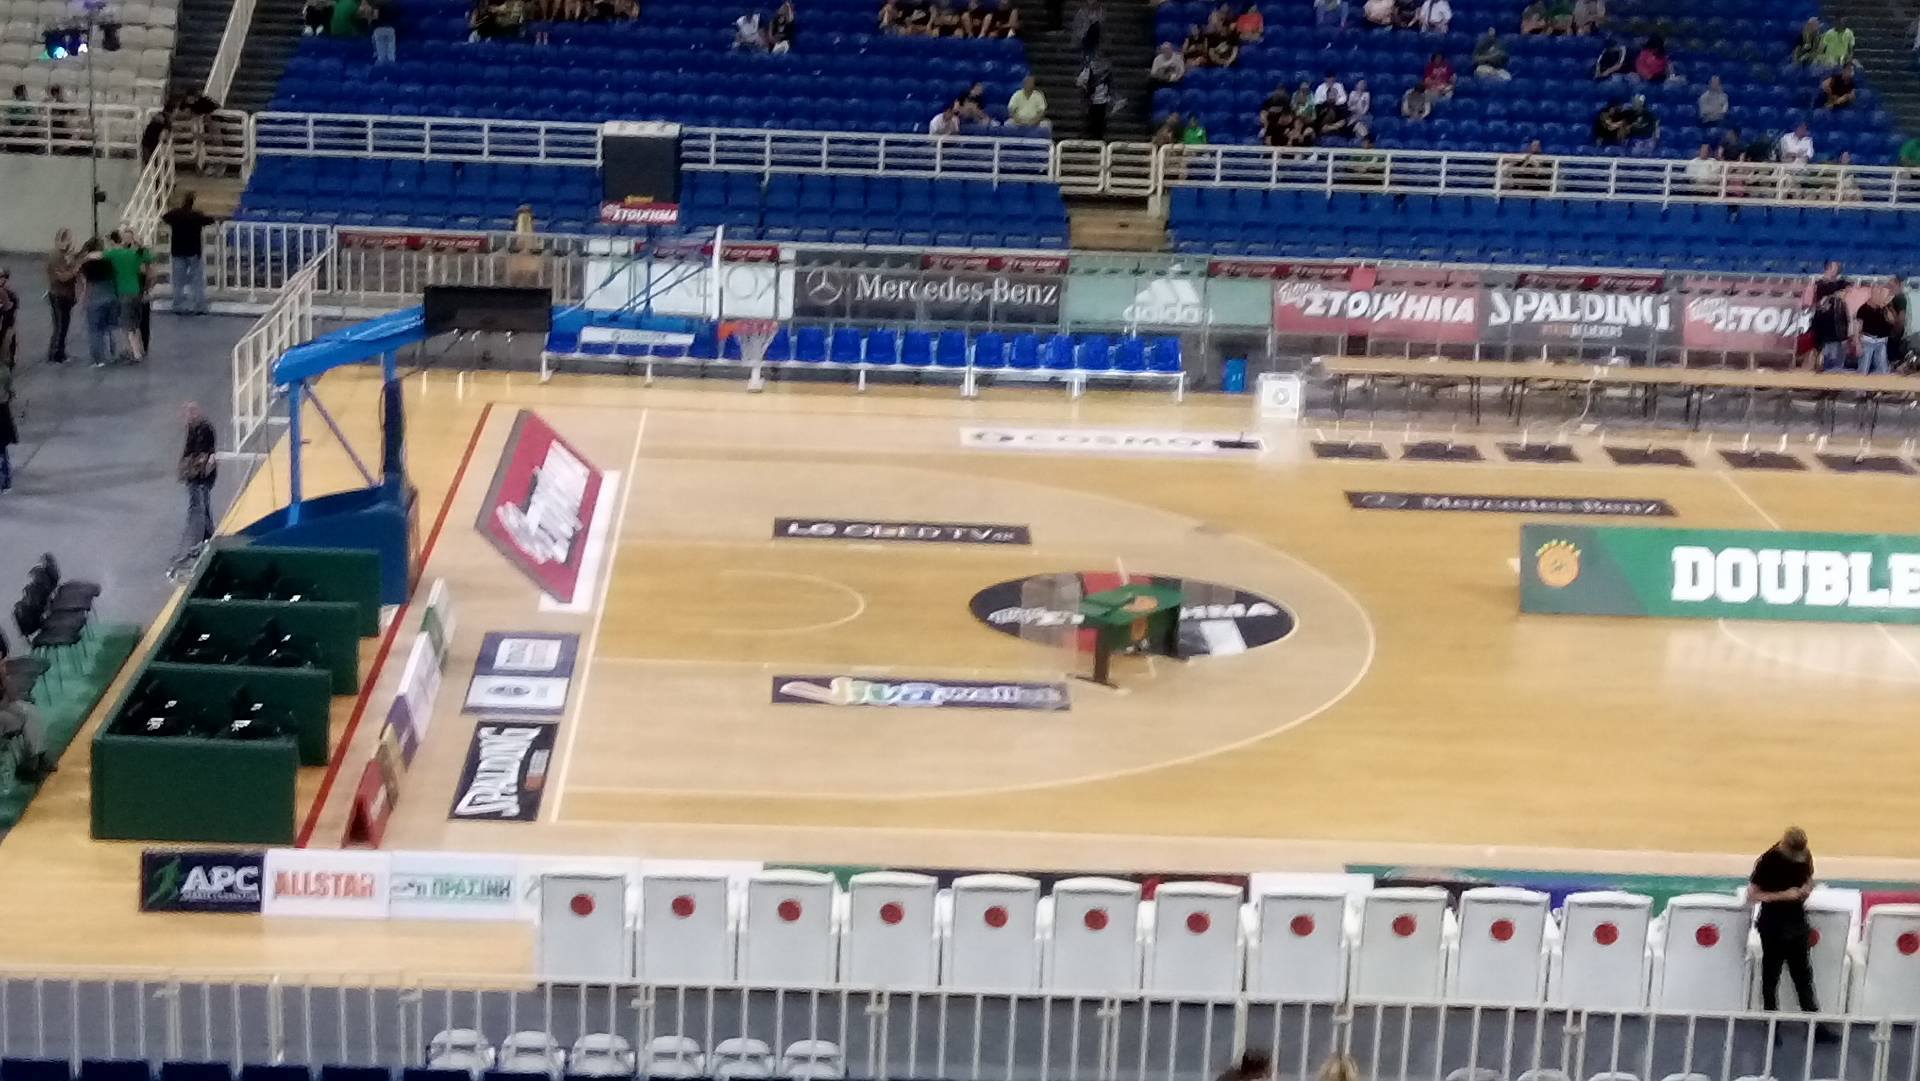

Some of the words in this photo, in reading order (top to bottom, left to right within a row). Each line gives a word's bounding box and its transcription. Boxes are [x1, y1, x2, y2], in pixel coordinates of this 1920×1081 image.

[856, 273, 1058, 306] Mercedes-Benz
[1671, 546, 1920, 608] DOUBLE
[180, 865, 260, 893] APC
